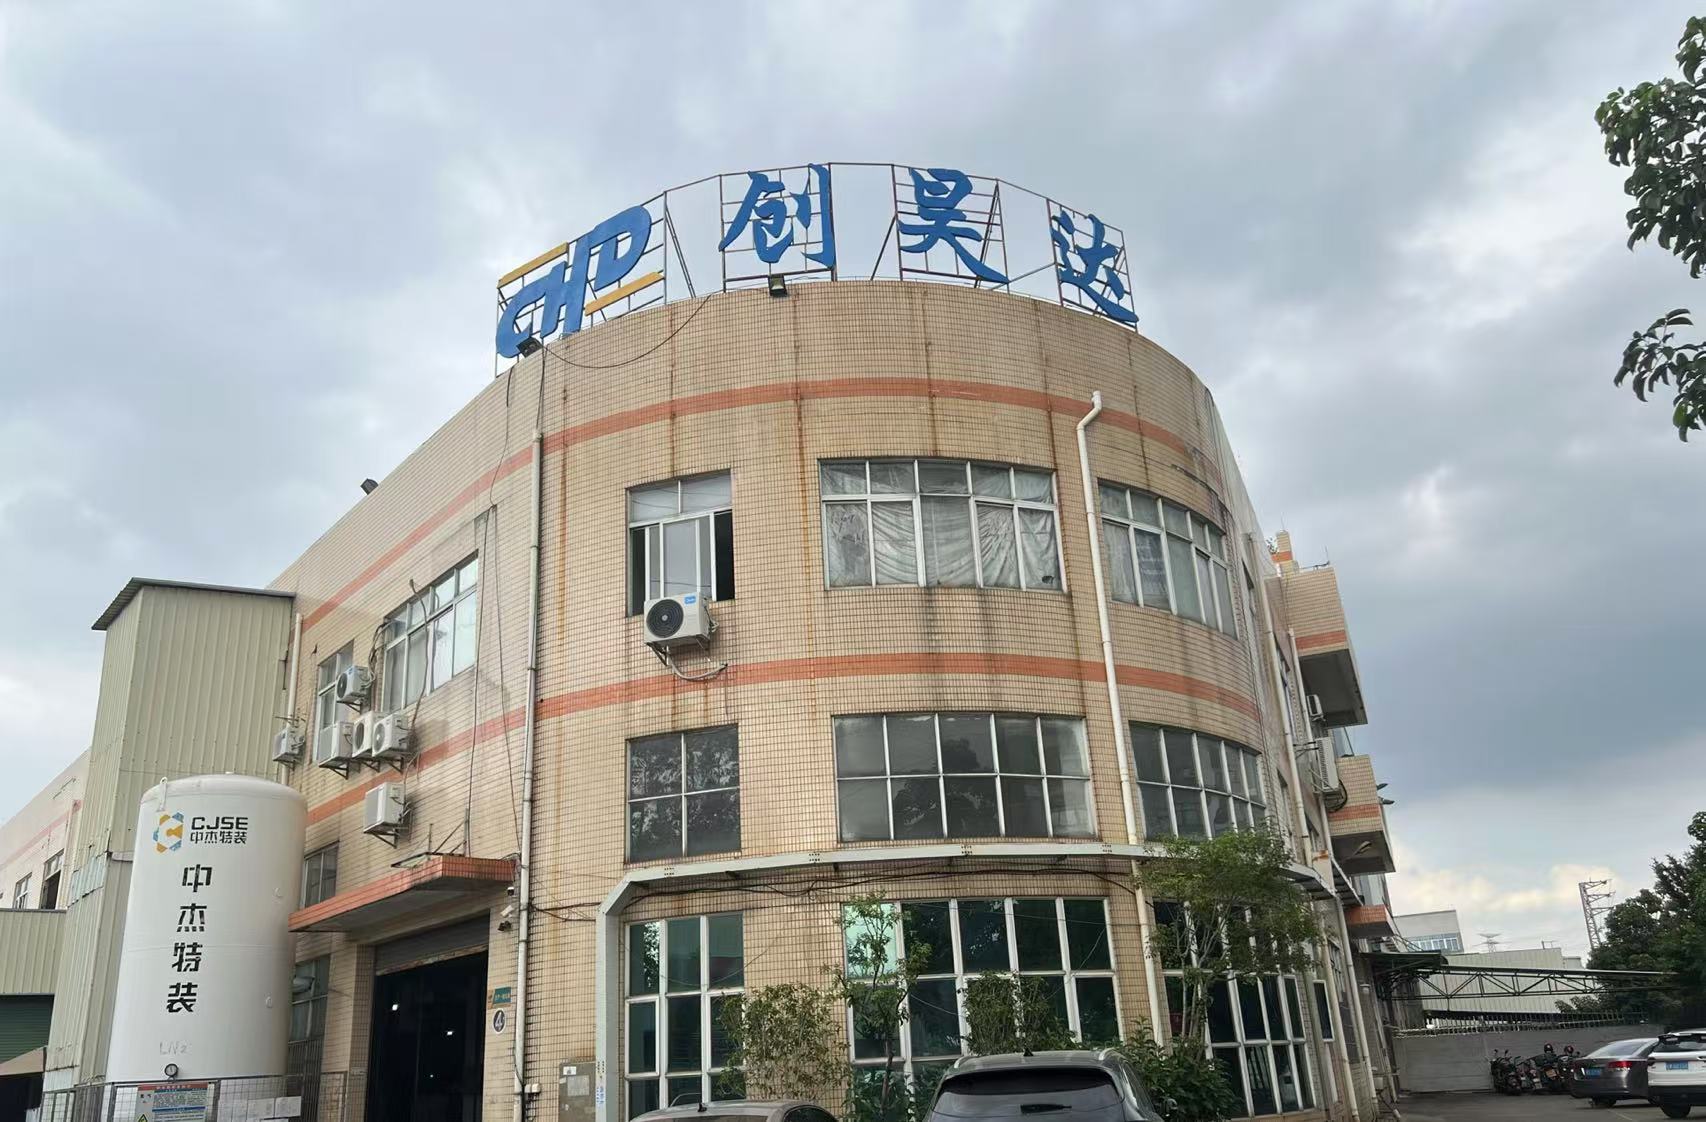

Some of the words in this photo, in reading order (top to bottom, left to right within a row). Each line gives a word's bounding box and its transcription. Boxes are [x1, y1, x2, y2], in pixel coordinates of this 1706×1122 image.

[718, 164, 1138, 323] 创昊达
[190, 831, 248, 845] 中杰特装
[191, 816, 249, 831] CJSE
[166, 863, 213, 1013] 中杰特装
